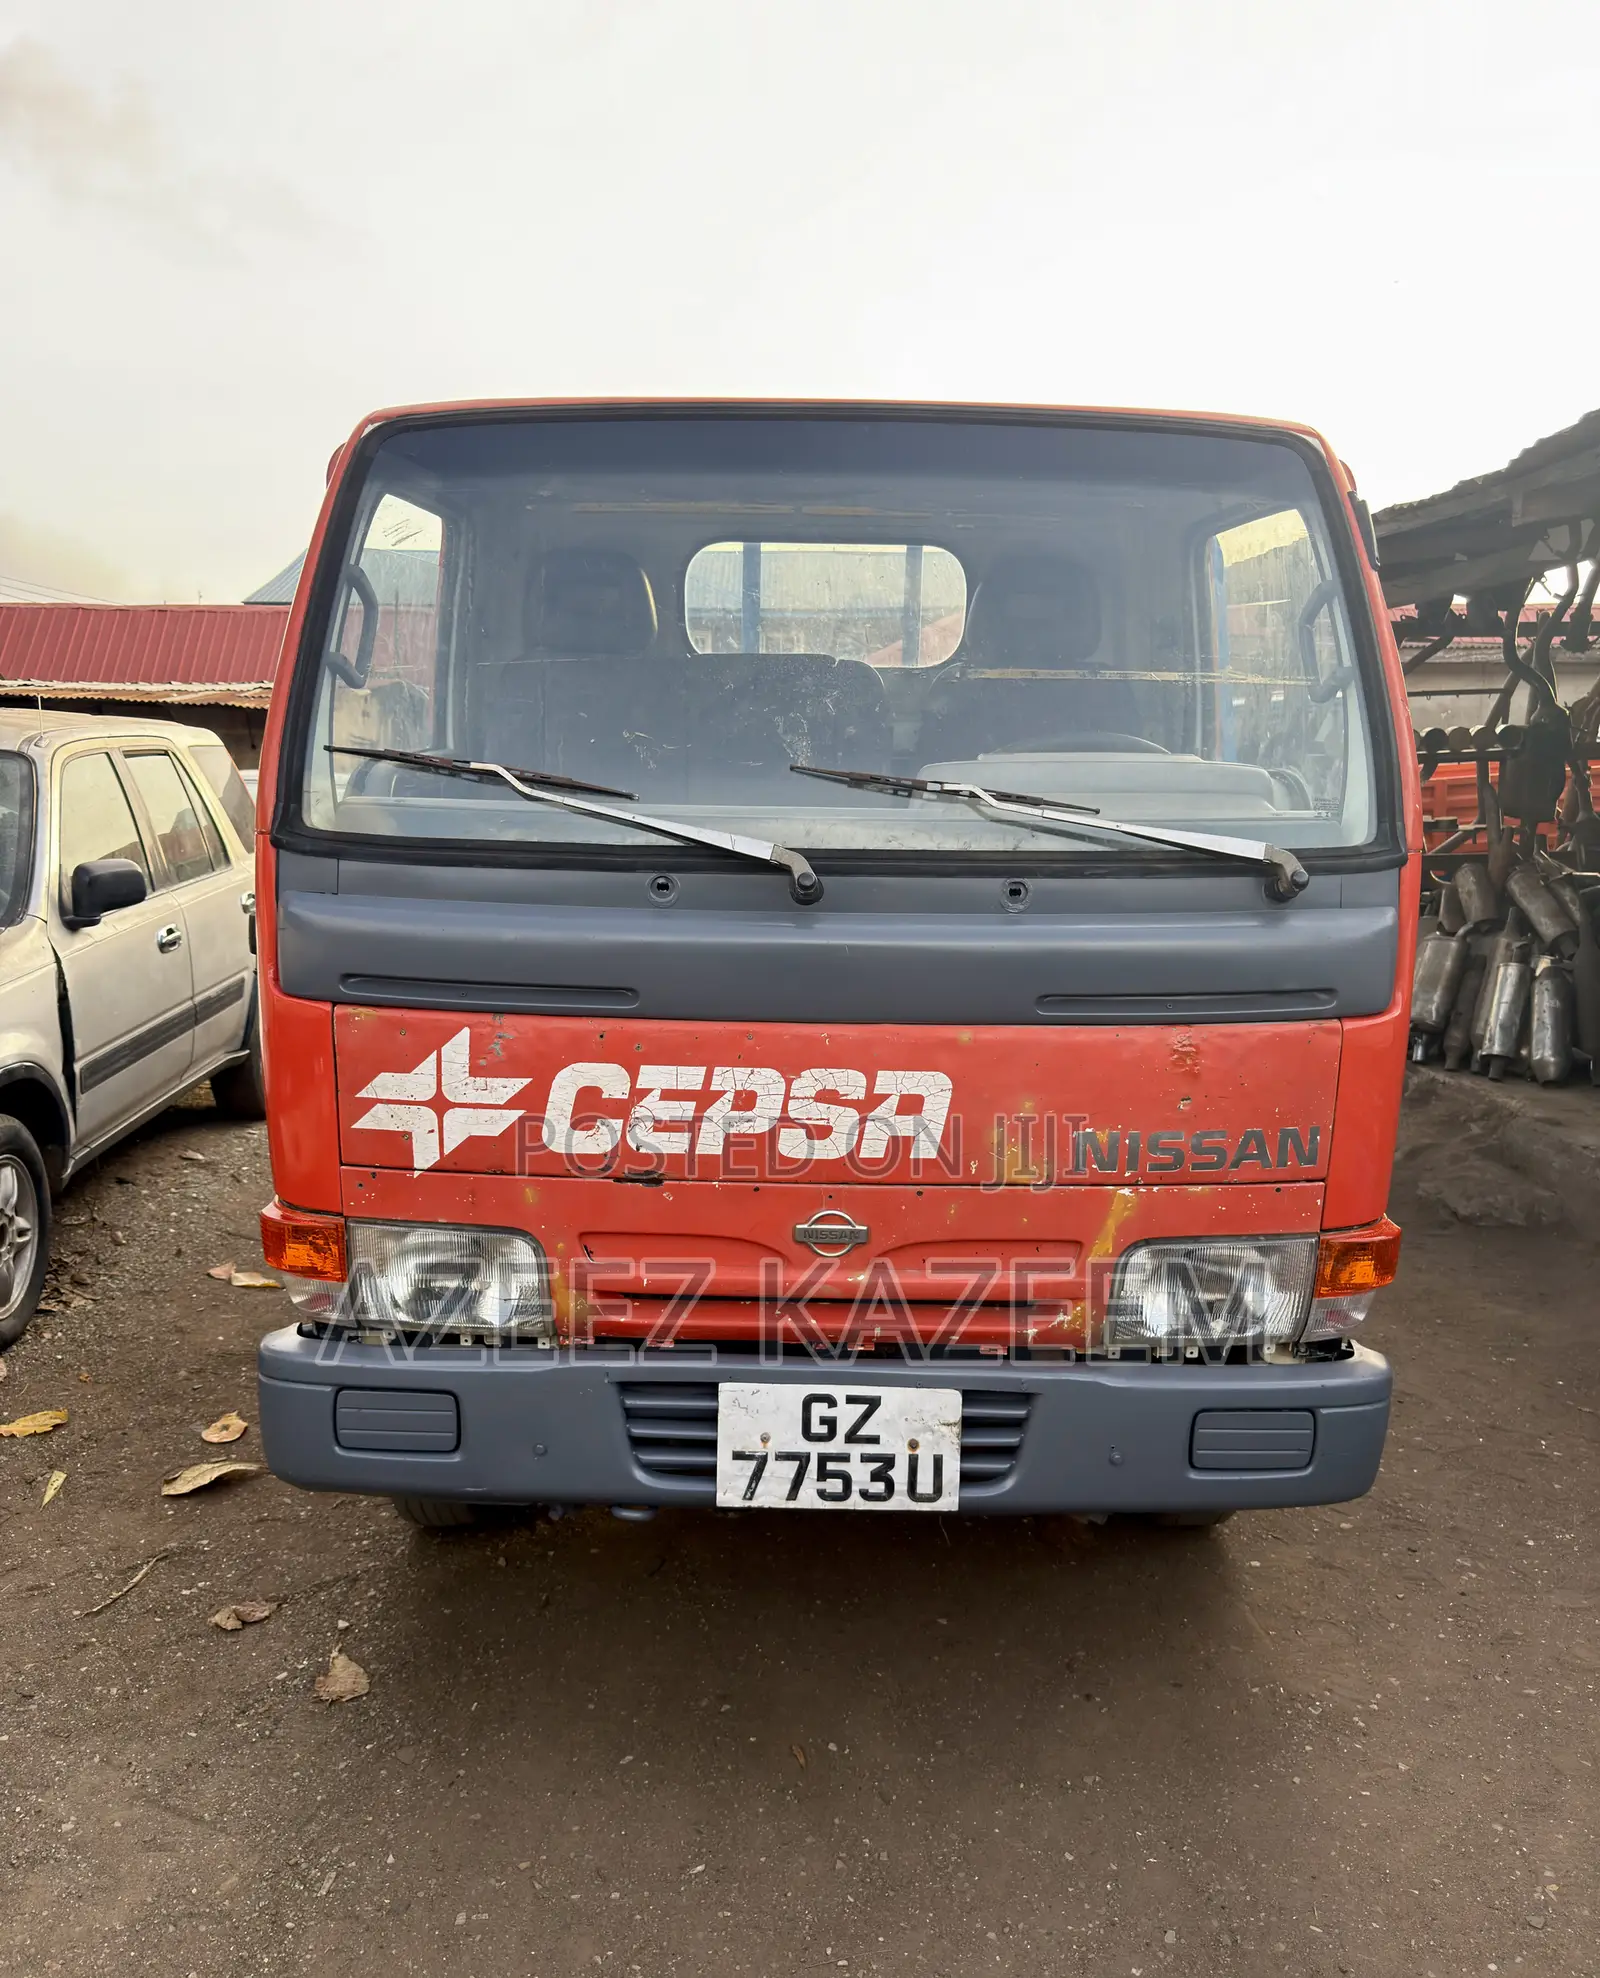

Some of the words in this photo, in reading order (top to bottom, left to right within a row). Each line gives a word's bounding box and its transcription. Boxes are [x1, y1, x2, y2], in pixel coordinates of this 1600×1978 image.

[541, 1062, 953, 1160] CEPSA
[1073, 1126, 1321, 1173] NISSAN
[803, 1229, 861, 1240] NISSAN
[802, 1393, 882, 1445] GZ
[732, 1450, 944, 1503] 7753U
